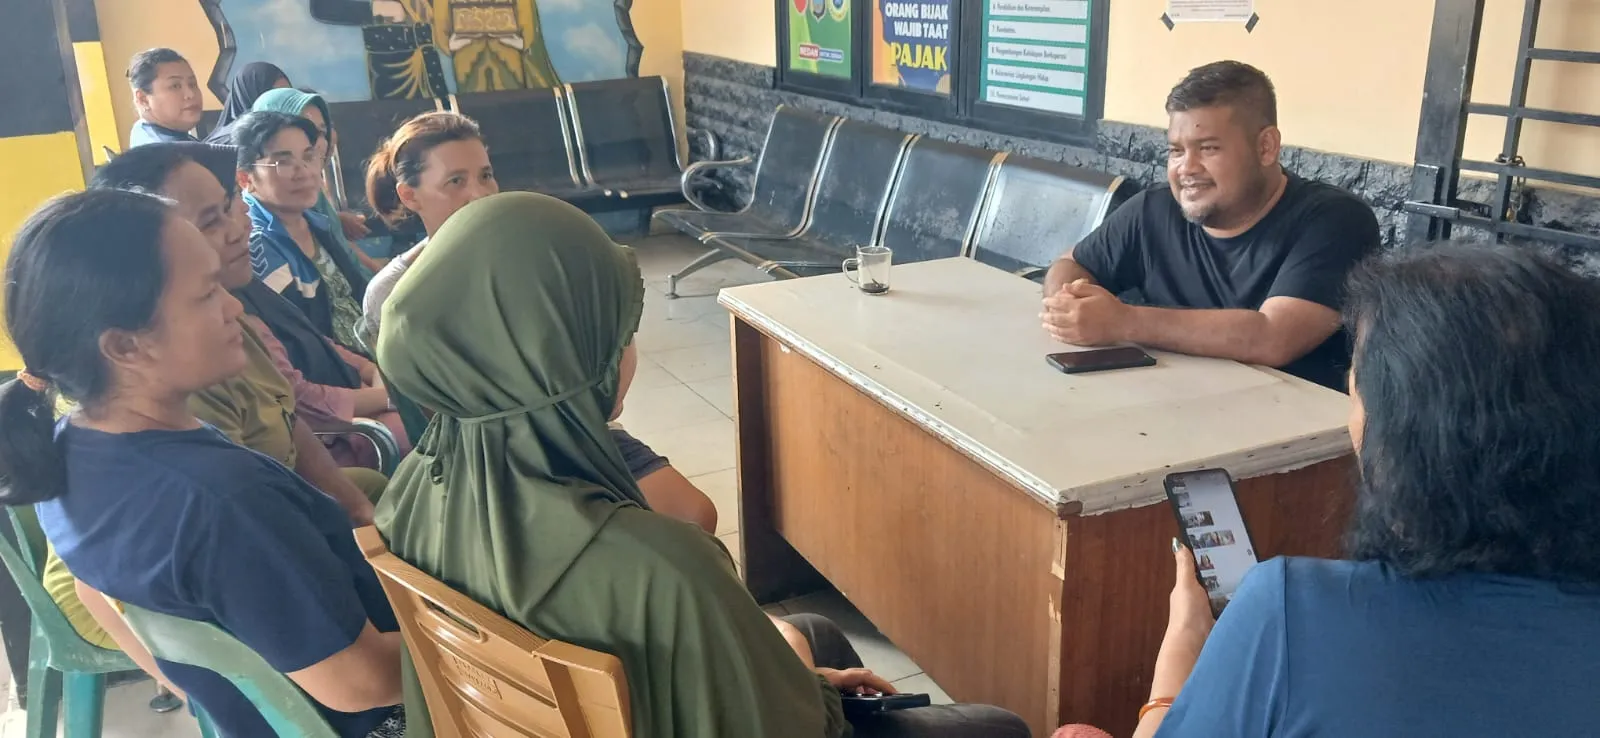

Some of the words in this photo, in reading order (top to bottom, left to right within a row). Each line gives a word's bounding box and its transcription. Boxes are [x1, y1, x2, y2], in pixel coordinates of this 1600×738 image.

[885, 3, 919, 18] ORANG
[921, 4, 948, 20] BIJAK
[894, 21, 921, 37] WAJIB
[923, 23, 948, 39] TAAT
[890, 42, 948, 72] PAJAK
